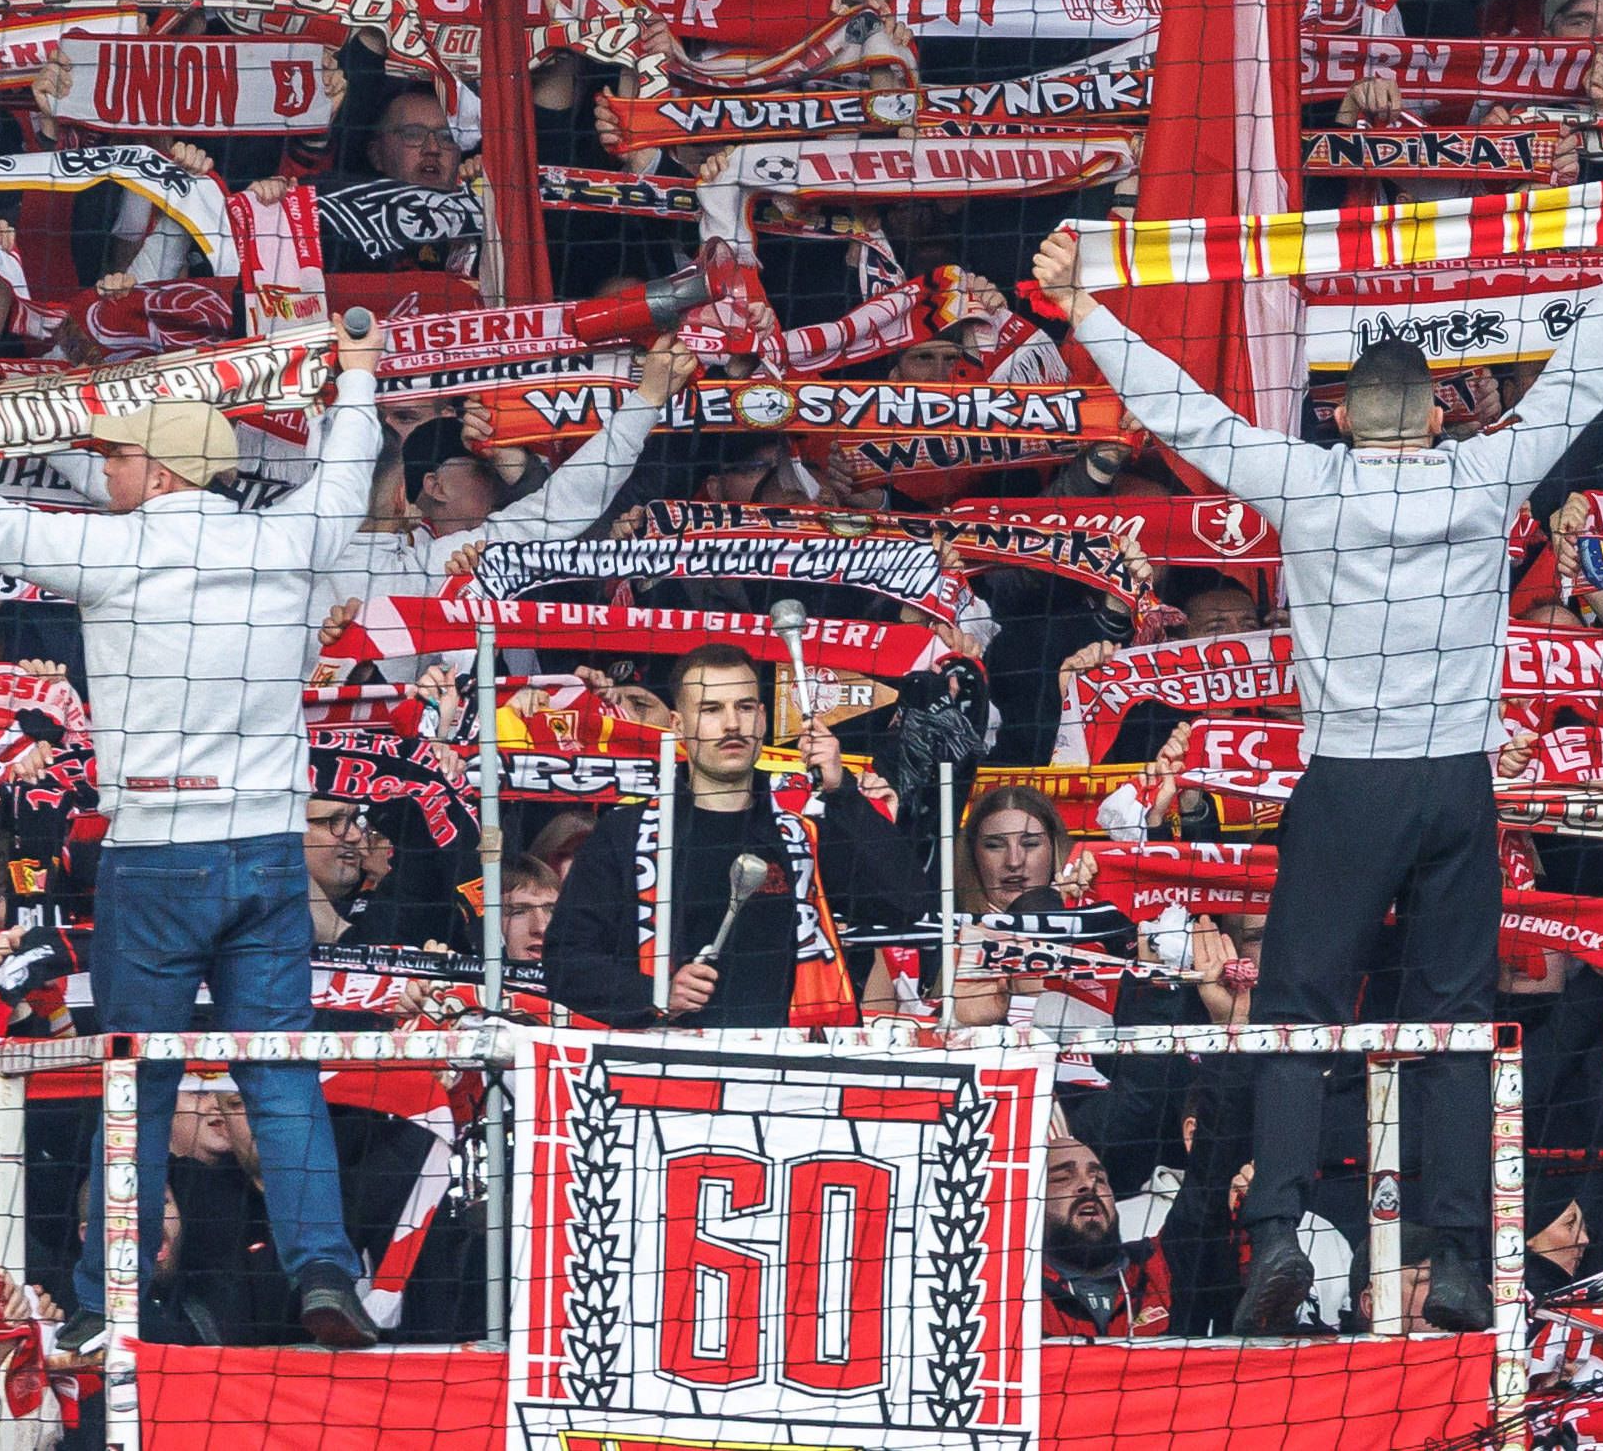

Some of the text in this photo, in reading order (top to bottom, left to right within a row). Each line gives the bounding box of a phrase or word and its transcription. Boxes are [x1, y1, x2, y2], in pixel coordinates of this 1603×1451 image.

[94, 39, 239, 128] UNION
[662, 97, 864, 132] WUHLE
[929, 148, 1102, 181] UNION
[392, 311, 545, 353] EISERN
[440, 598, 522, 627] NUR
[1132, 885, 1189, 909] MACHE
[654, 1144, 902, 1393] 60
